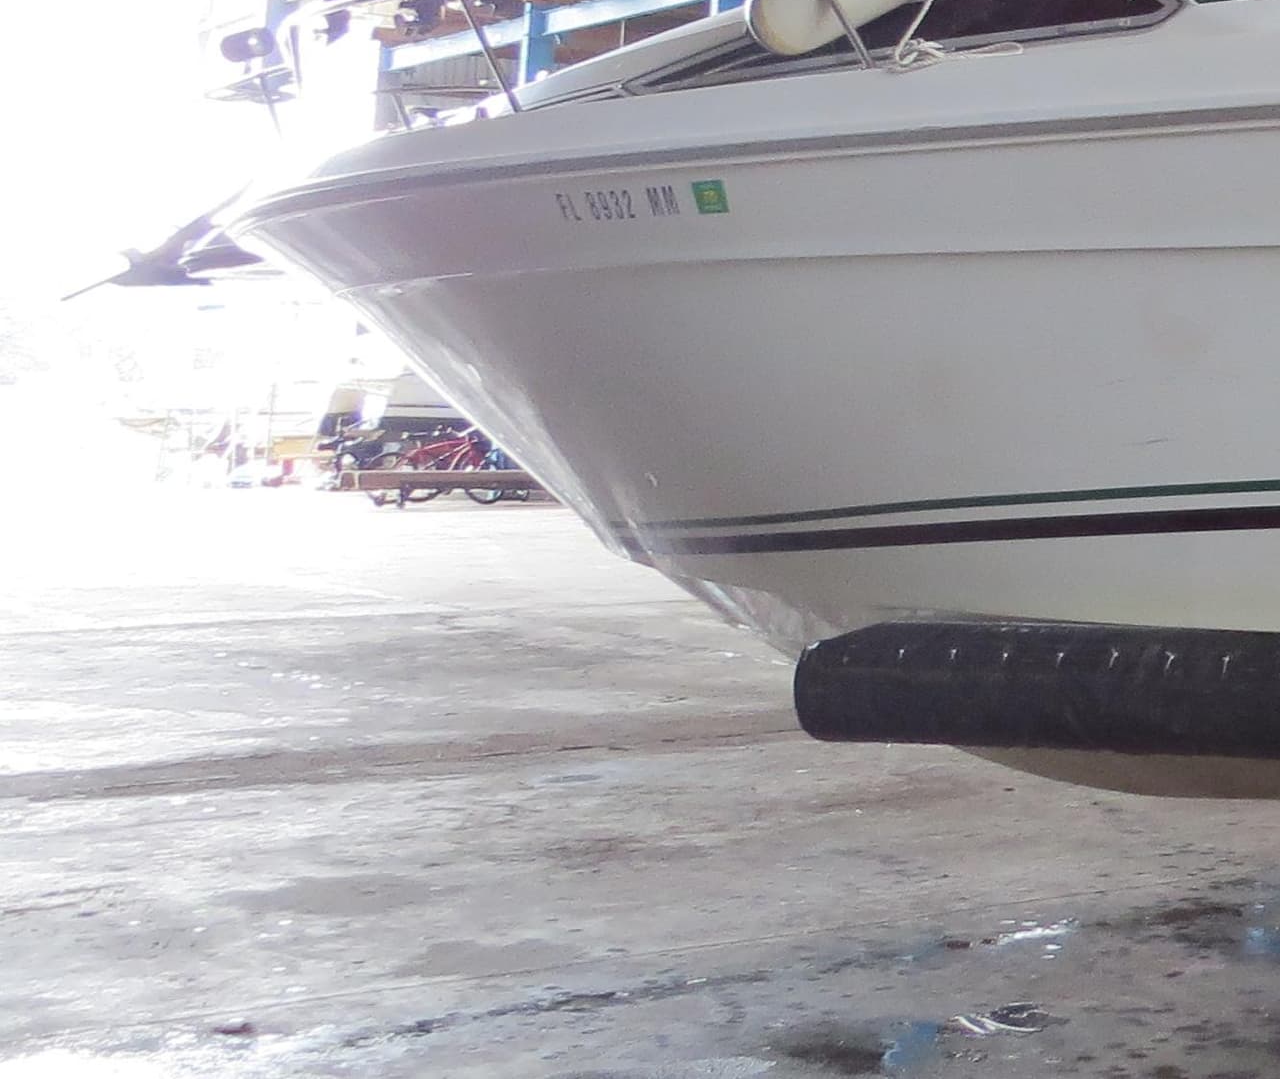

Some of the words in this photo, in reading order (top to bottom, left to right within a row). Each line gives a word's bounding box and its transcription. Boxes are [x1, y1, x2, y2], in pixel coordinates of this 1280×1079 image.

[555, 193, 582, 221] FL
[584, 190, 636, 220] 8932
[646, 185, 680, 216] MM
